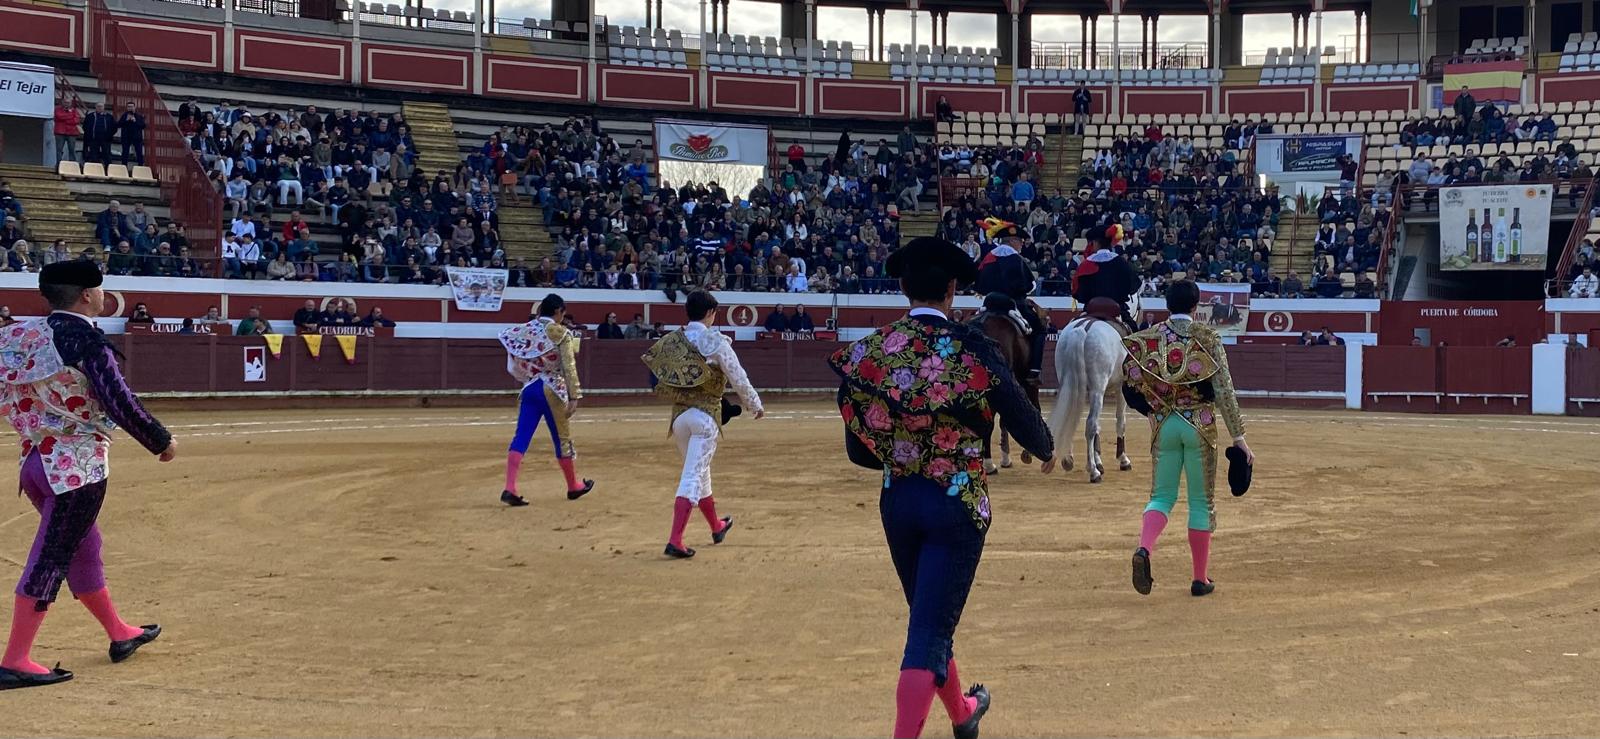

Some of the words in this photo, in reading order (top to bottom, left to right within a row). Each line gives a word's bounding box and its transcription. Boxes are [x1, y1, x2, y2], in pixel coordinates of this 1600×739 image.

[0, 80, 12, 91] El
[16, 81, 47, 95] Tejar
[739, 308, 748, 324] 4
[1420, 308, 1448, 317] PUERTA
[1449, 308, 1460, 317] DE
[1463, 306, 1499, 317] CÓRDOBA
[1273, 314, 1283, 330] 2
[319, 326, 375, 336] CUADRILLAS
